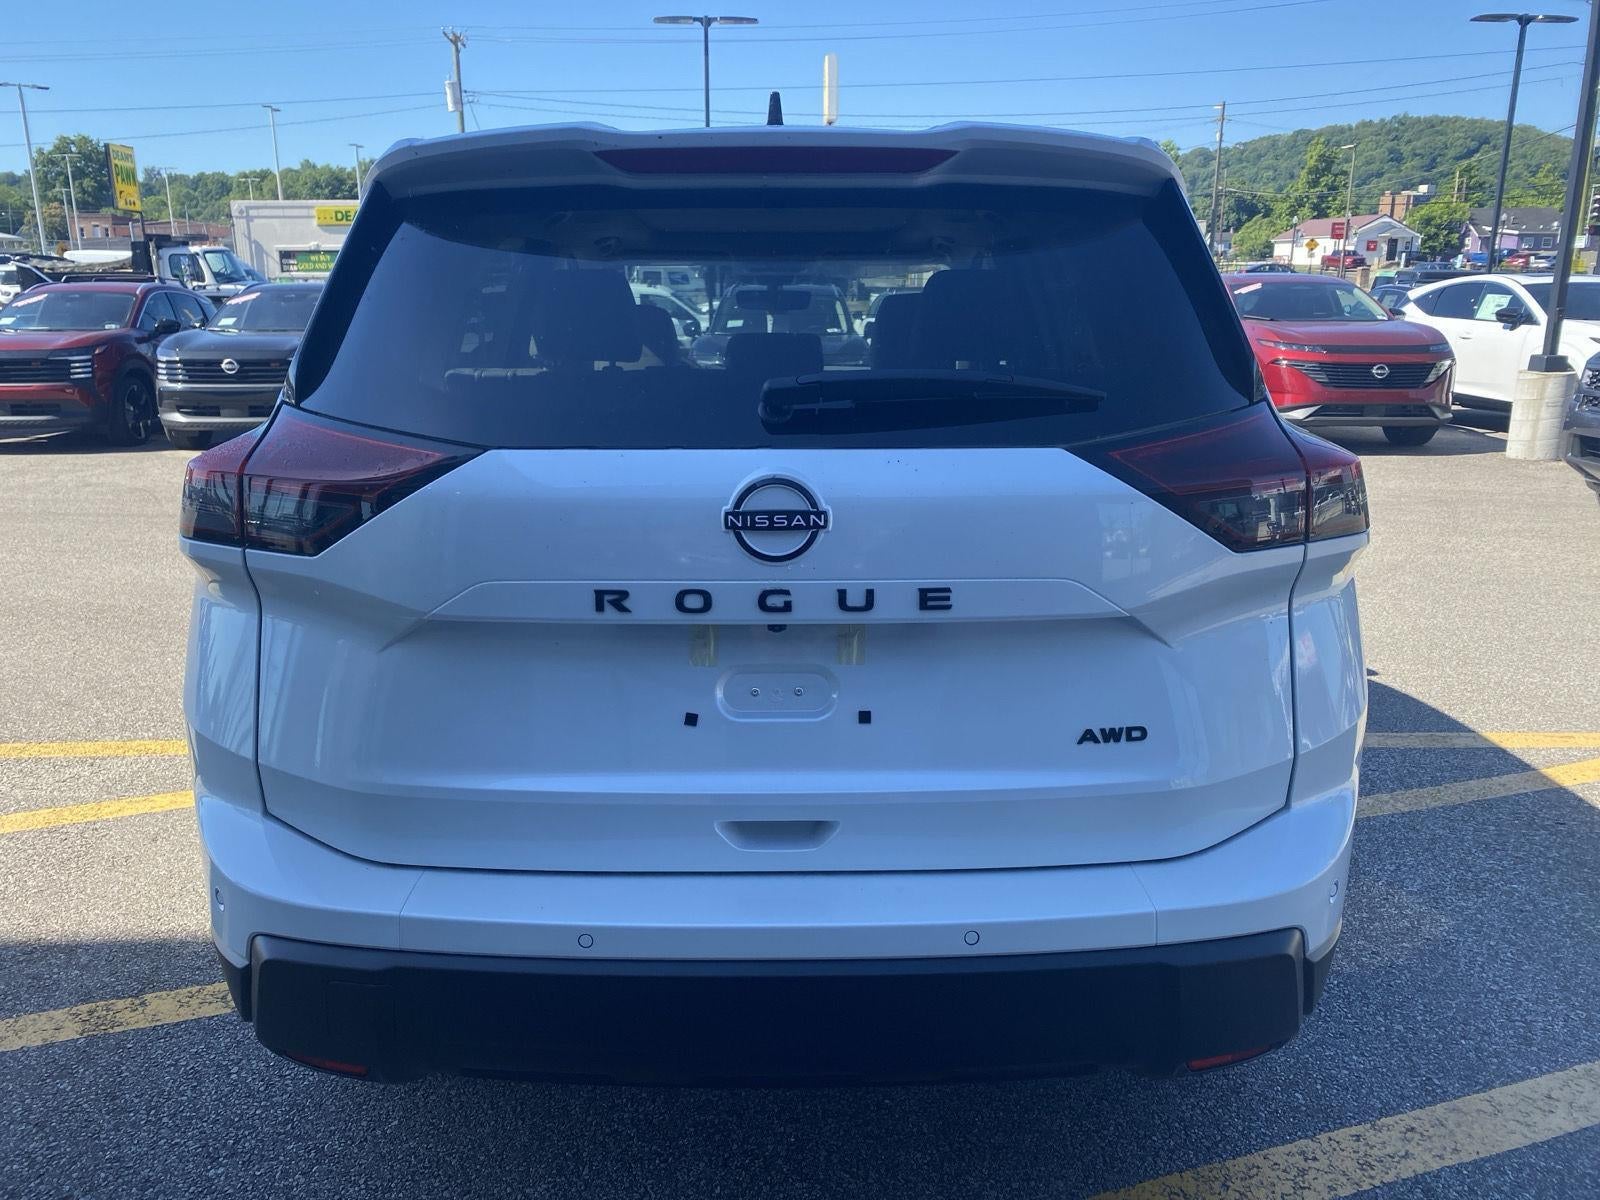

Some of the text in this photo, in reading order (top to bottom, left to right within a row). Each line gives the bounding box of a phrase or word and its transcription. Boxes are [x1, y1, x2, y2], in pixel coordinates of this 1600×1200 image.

[114, 163, 136, 187] PAWN
[728, 514, 825, 527] NISSAN
[594, 587, 953, 613] ROGUE
[1077, 725, 1149, 745] AWD
